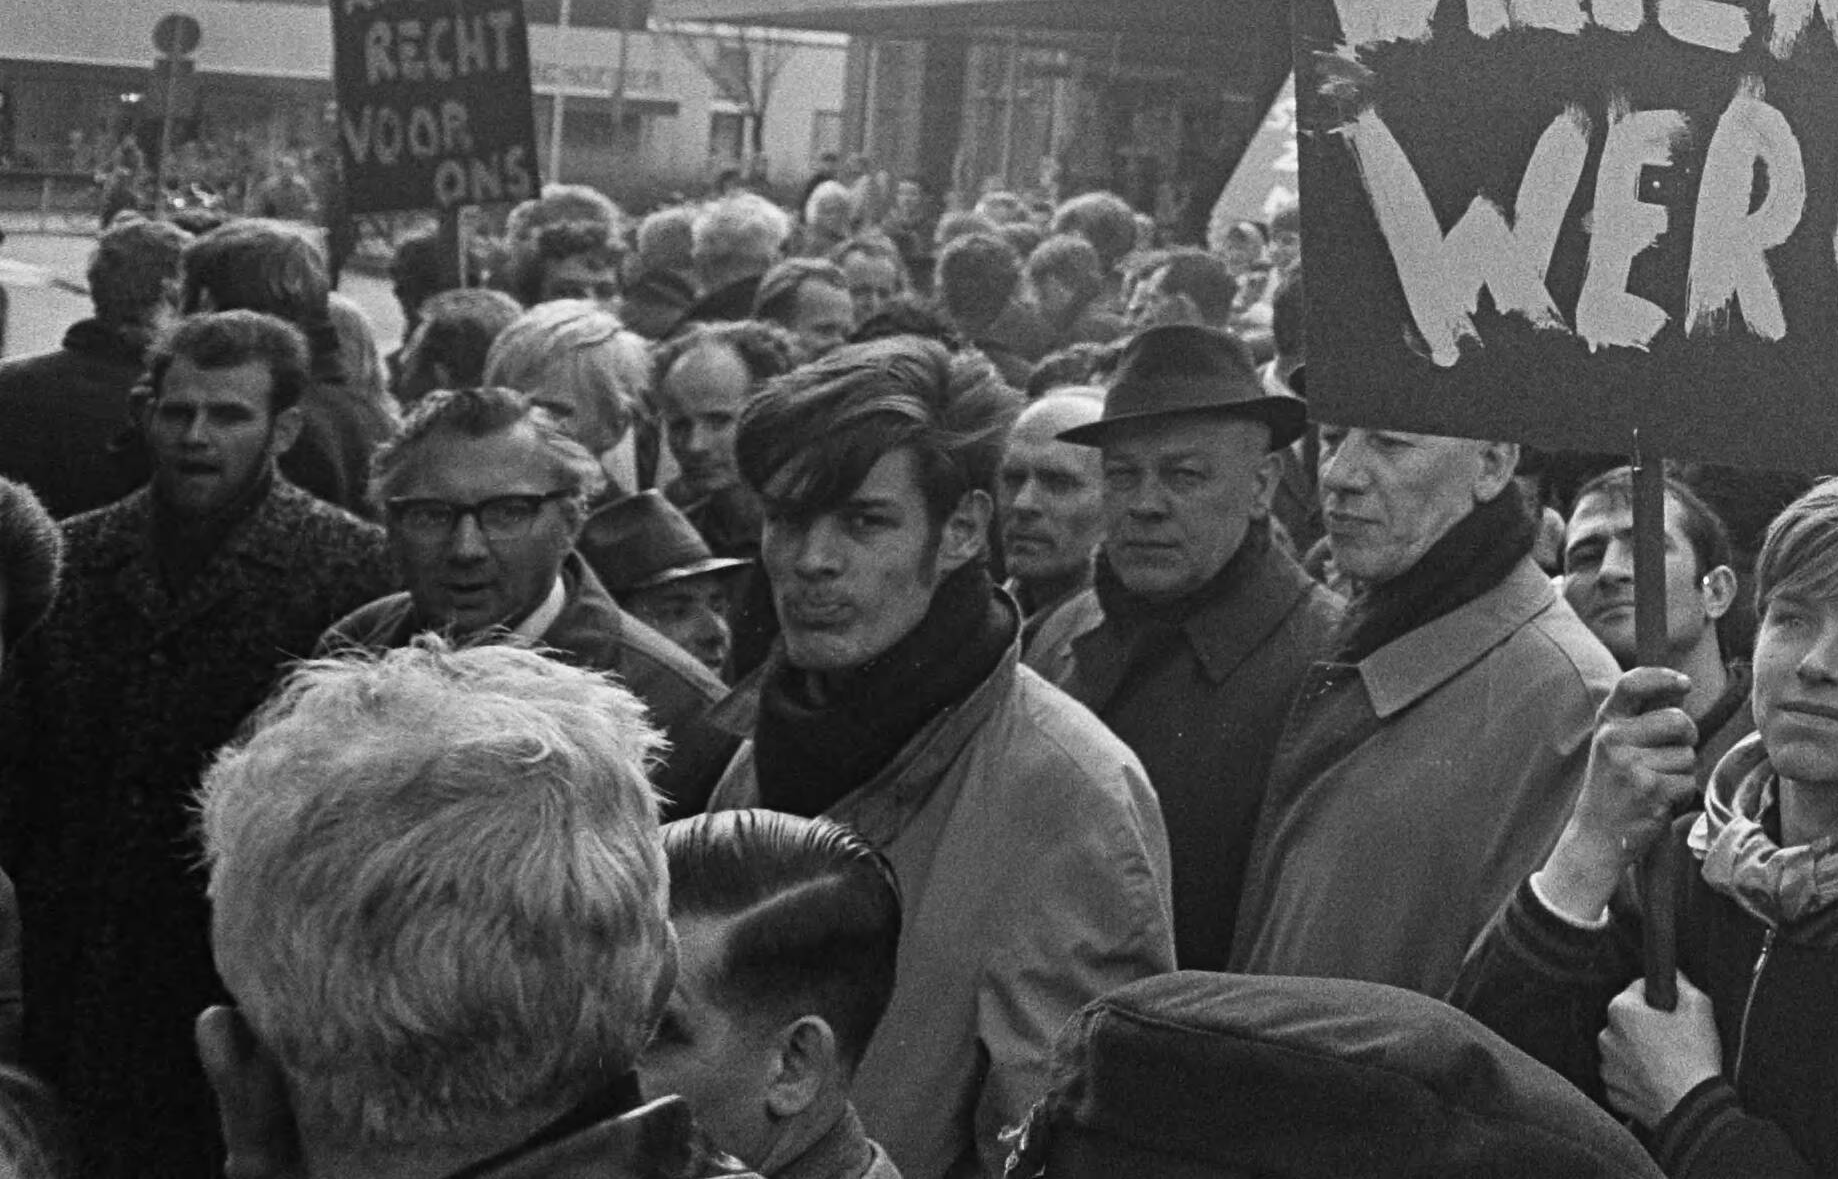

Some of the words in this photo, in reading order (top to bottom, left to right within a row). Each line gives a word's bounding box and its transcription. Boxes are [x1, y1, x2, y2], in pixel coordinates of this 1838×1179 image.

[365, 11, 514, 85] RECHT
[342, 101, 473, 164] VOOR
[434, 146, 530, 208] ONS
